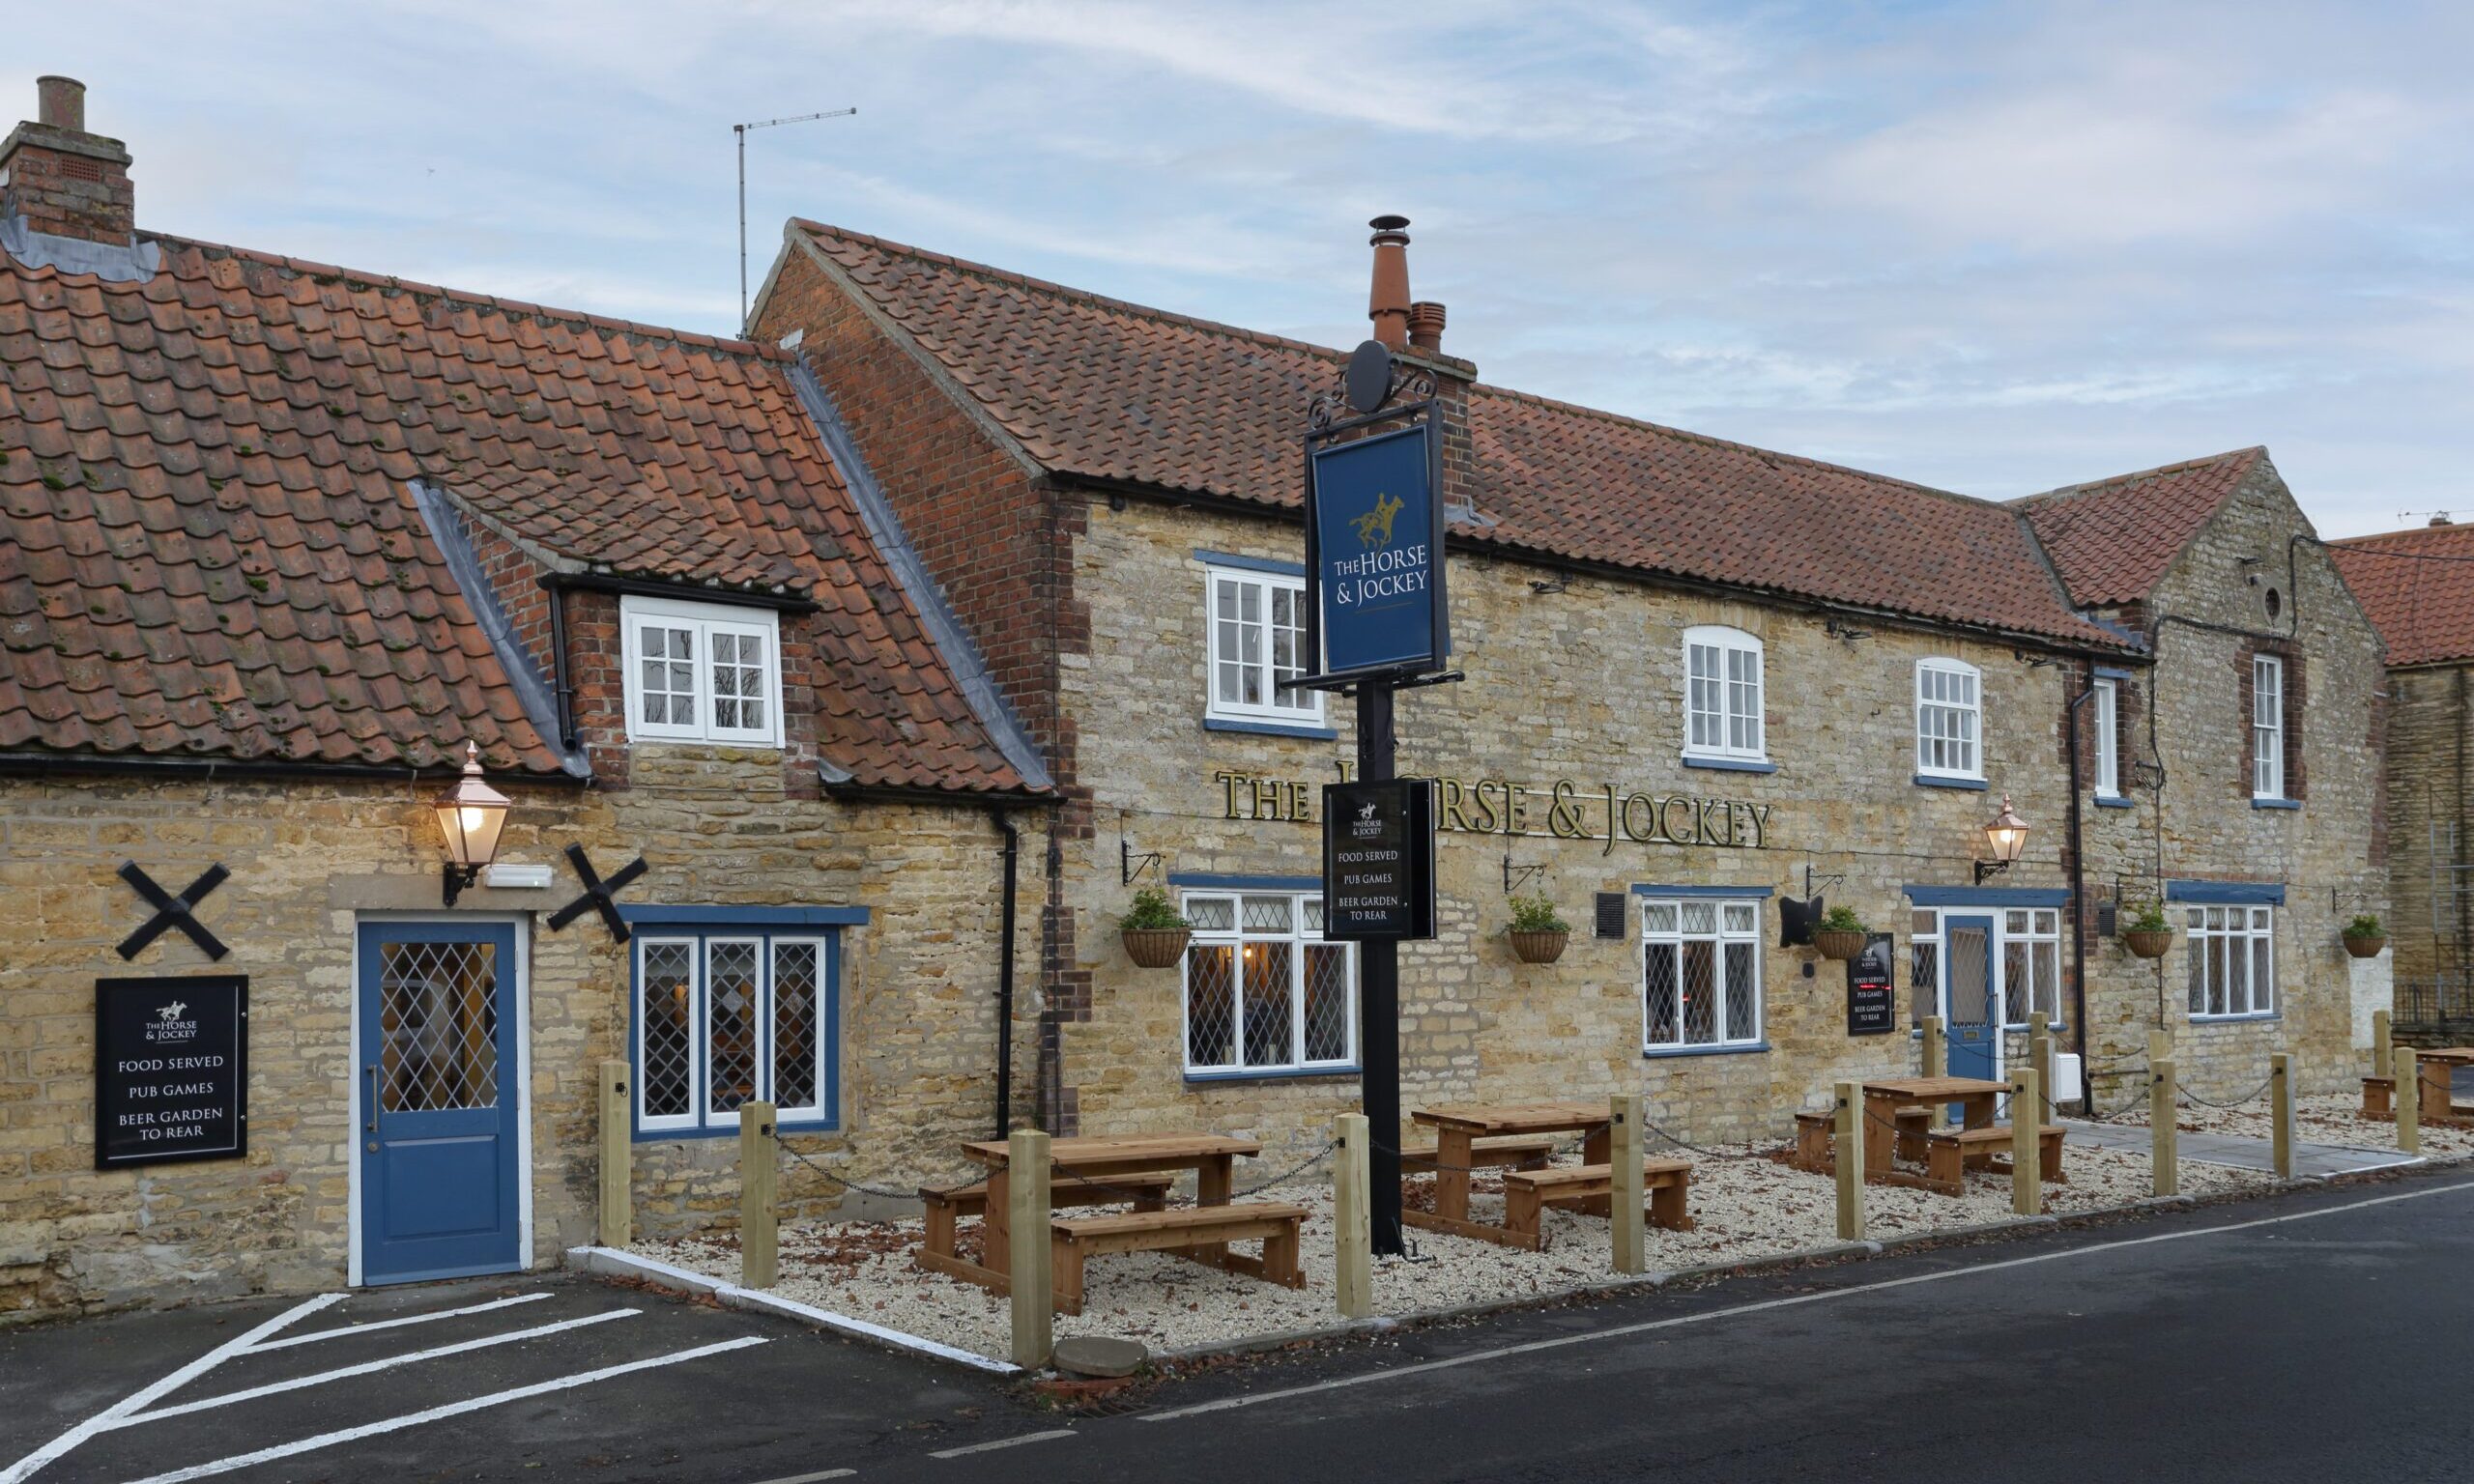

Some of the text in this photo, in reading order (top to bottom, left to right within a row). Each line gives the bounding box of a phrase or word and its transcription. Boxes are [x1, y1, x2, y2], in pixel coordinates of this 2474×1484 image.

[1335, 544, 1427, 576] THE HORSE
[1337, 570, 1428, 608] & JOCKEY
[1215, 760, 1777, 857] THE RSE & JOCKEY
[1361, 819, 1382, 828] HORSE
[1359, 827, 1382, 837] JOCKEY
[1338, 850, 1398, 863] FOOD SERVED
[1344, 873, 1393, 884] PUB GAMES
[1338, 896, 1398, 907] BEER GARDEN
[1350, 910, 1387, 921] TO REAR
[160, 1021, 197, 1030] HORSE
[146, 1030, 197, 1042] & JOCKEY
[119, 1056, 224, 1072] FOOD SERVED
[129, 1082, 214, 1099] PUB GAMES
[119, 1108, 223, 1127] BEER GARDEN
[139, 1126, 204, 1141] TO REAR
